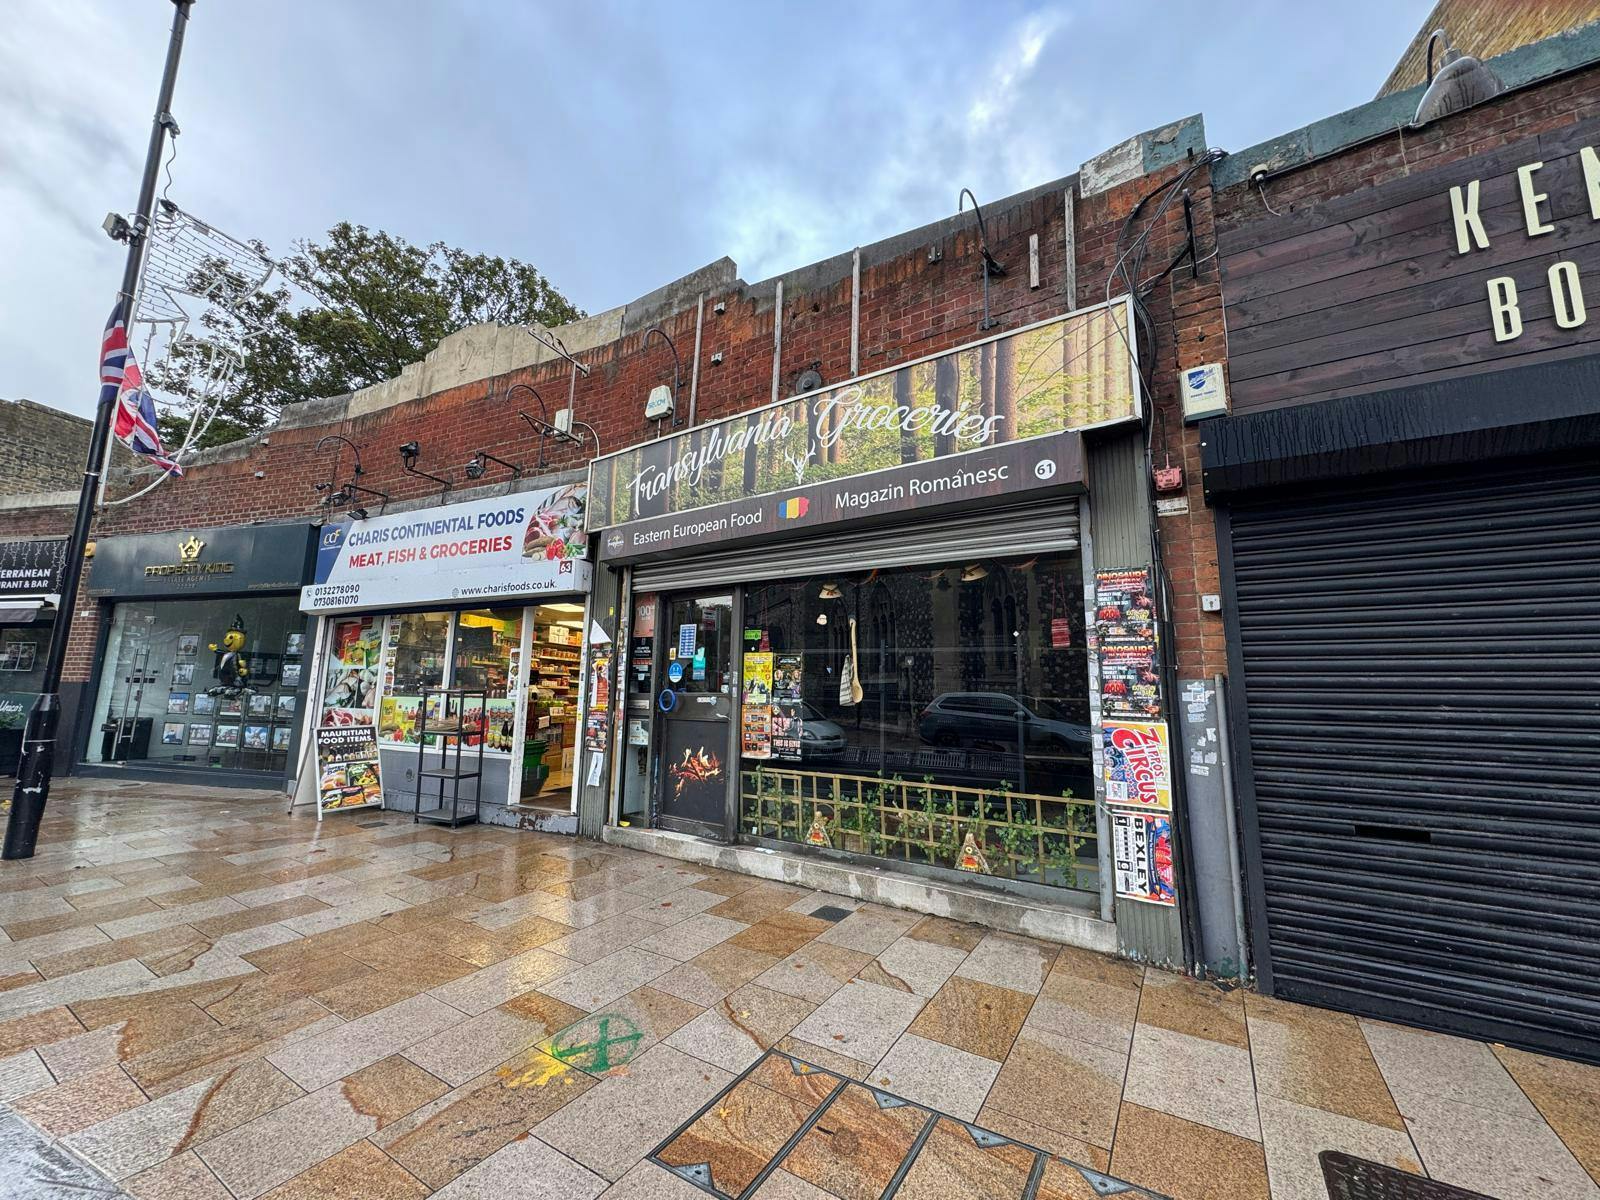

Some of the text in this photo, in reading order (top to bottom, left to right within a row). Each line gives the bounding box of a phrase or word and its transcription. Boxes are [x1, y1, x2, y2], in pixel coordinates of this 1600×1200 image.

[1487, 261, 1587, 342] BO
[626, 384, 1005, 516] Transylvania Groceries
[835, 463, 1054, 509] Magazin Românesc 61
[349, 507, 525, 547] CHARIS CONTINENTAL FOODS
[633, 525, 671, 546] Eastern
[673, 516, 728, 542] European
[731, 507, 762, 529] Food
[349, 535, 512, 568] MEAT, FISH & GROCERIES
[561, 562, 571, 572] 63
[0, 569, 51, 578] ERRANEAN
[0, 581, 23, 589] RANT
[31, 580, 49, 588] BAR
[461, 580, 555, 595] www.charisfoods.co.uk
[1097, 570, 1148, 581] DINOSAURS
[1101, 646, 1154, 655] DINOSAURS
[321, 729, 370, 738] MAURITIAN
[347, 735, 374, 743] ITEMS.
[1112, 728, 1158, 804] CIRCUS
[1137, 727, 1166, 778] ZIPPOS
[1134, 818, 1148, 893] BEXLEY
